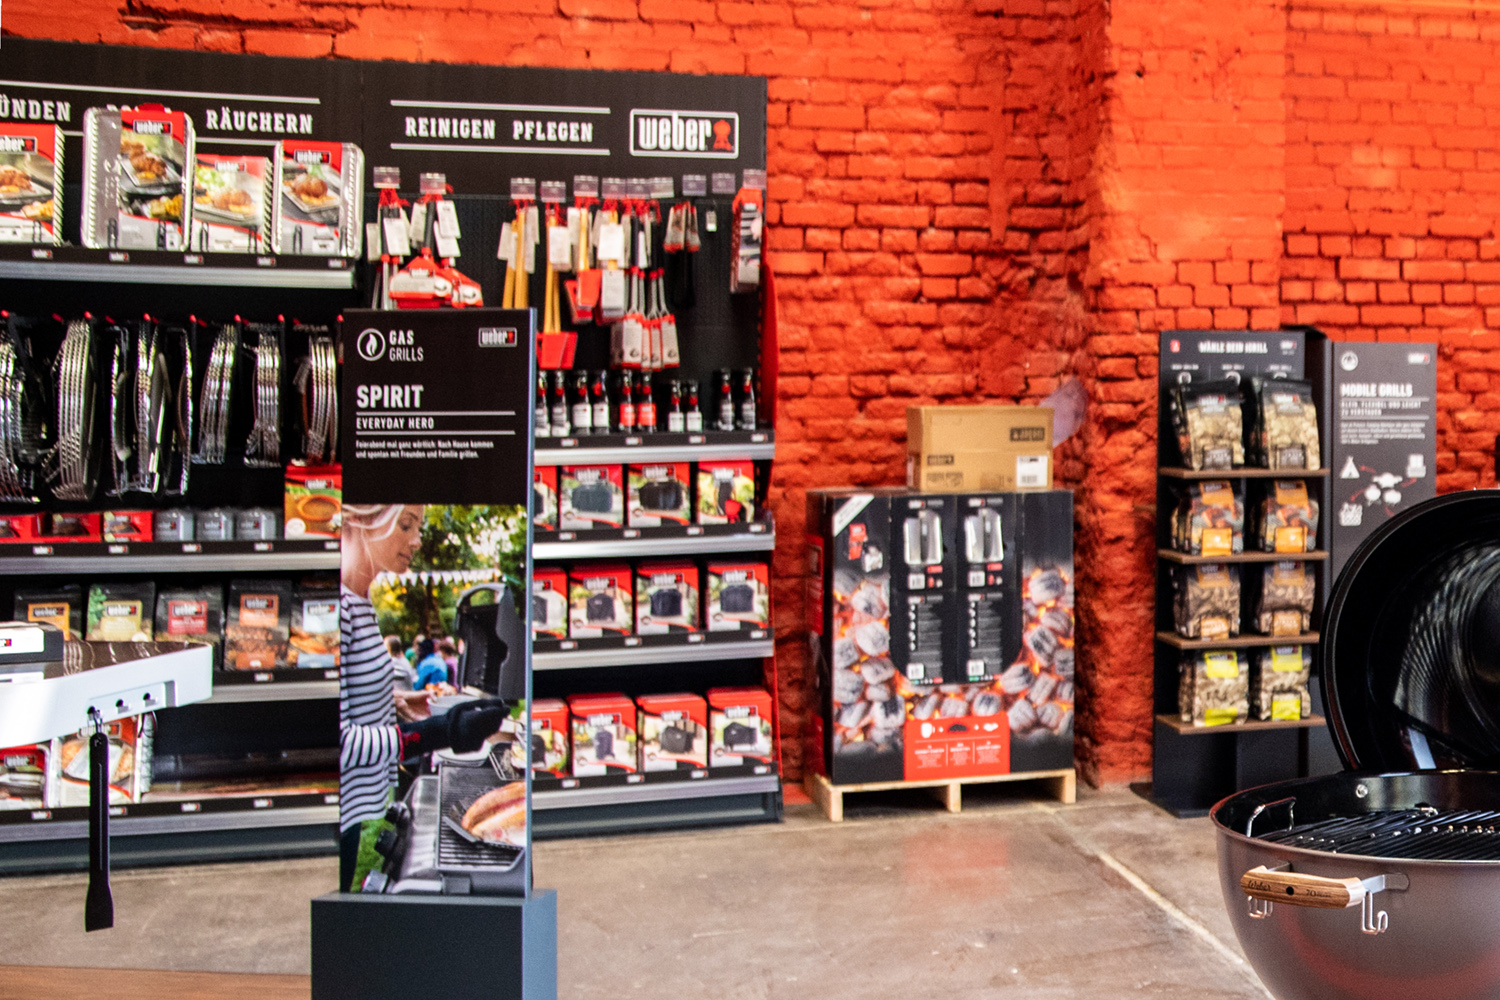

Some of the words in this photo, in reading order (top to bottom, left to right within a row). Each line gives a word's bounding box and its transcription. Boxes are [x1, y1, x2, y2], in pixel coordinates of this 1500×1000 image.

[206, 107, 313, 134] RÄUCHERN
[405, 117, 496, 139] REINIGEN
[513, 121, 593, 142] PFLEGEN
[638, 112, 712, 151] weber
[388, 330, 414, 345] GAS
[389, 347, 424, 361] GRILLS
[356, 384, 424, 408] SPIRIT
[356, 417, 404, 429] EVERYDAY
[408, 417, 434, 429] HERO
